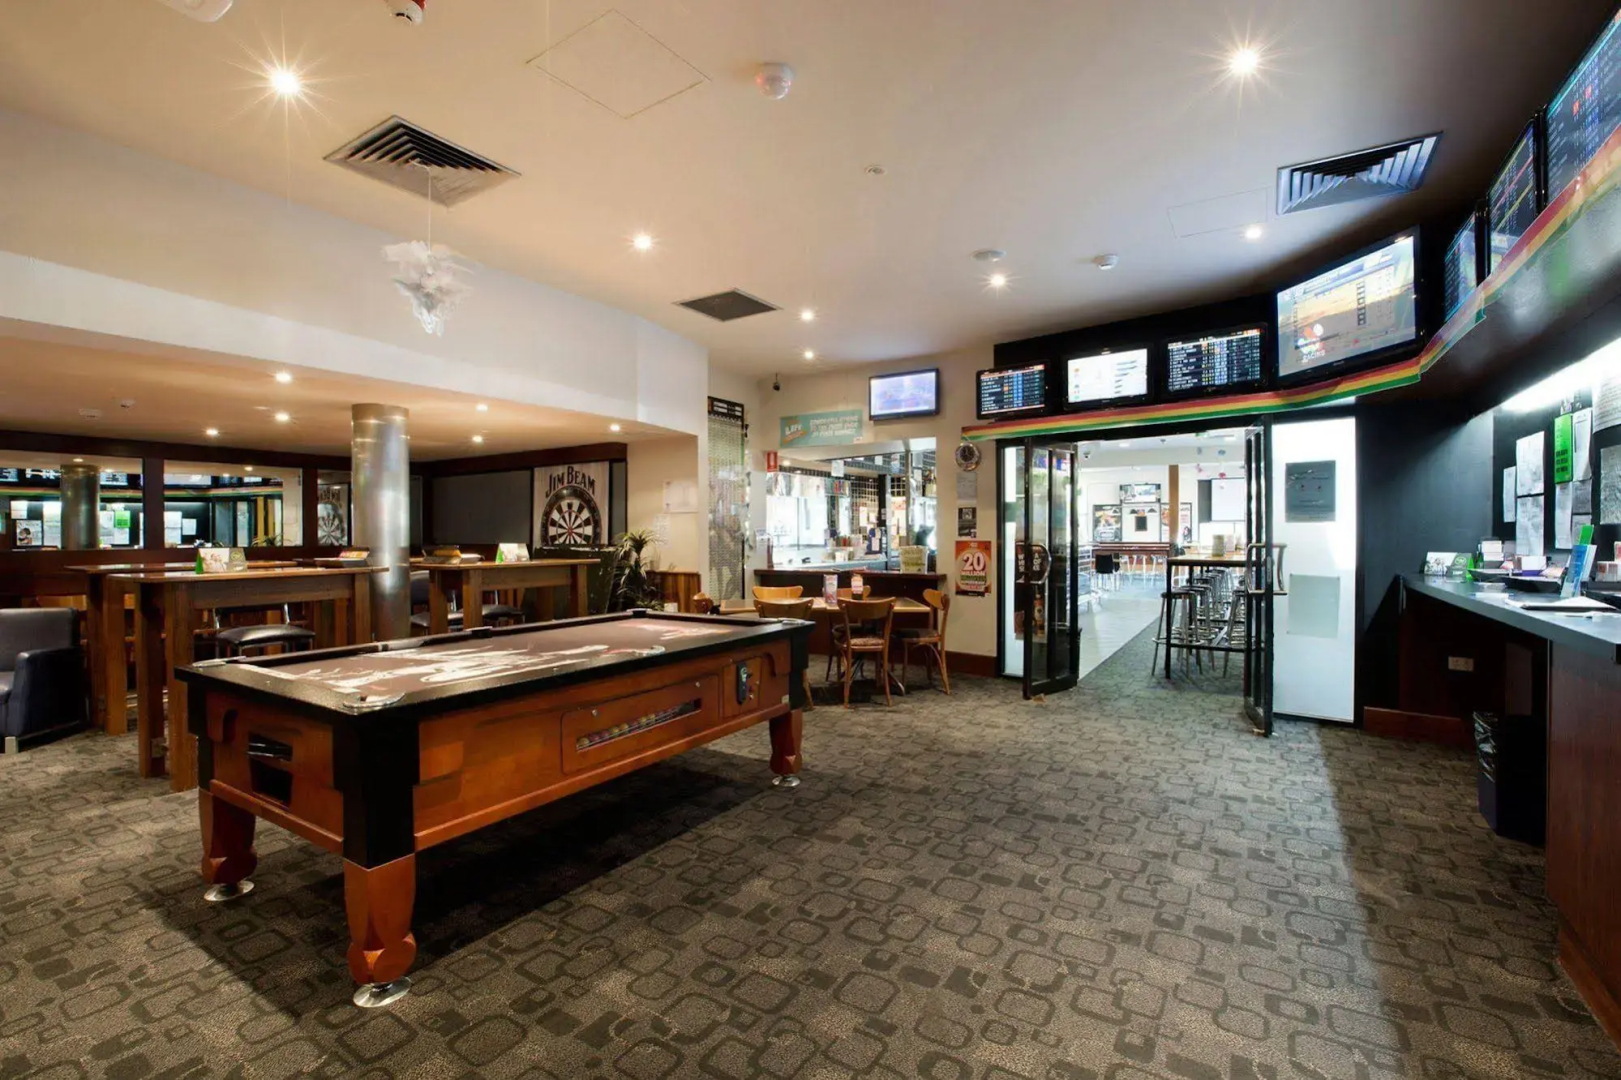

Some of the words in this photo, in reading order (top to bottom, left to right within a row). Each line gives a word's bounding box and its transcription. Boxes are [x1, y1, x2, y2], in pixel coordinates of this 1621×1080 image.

[545, 472, 565, 498] JIM
[567, 466, 596, 495] BEAM
[963, 551, 985, 571] 20
